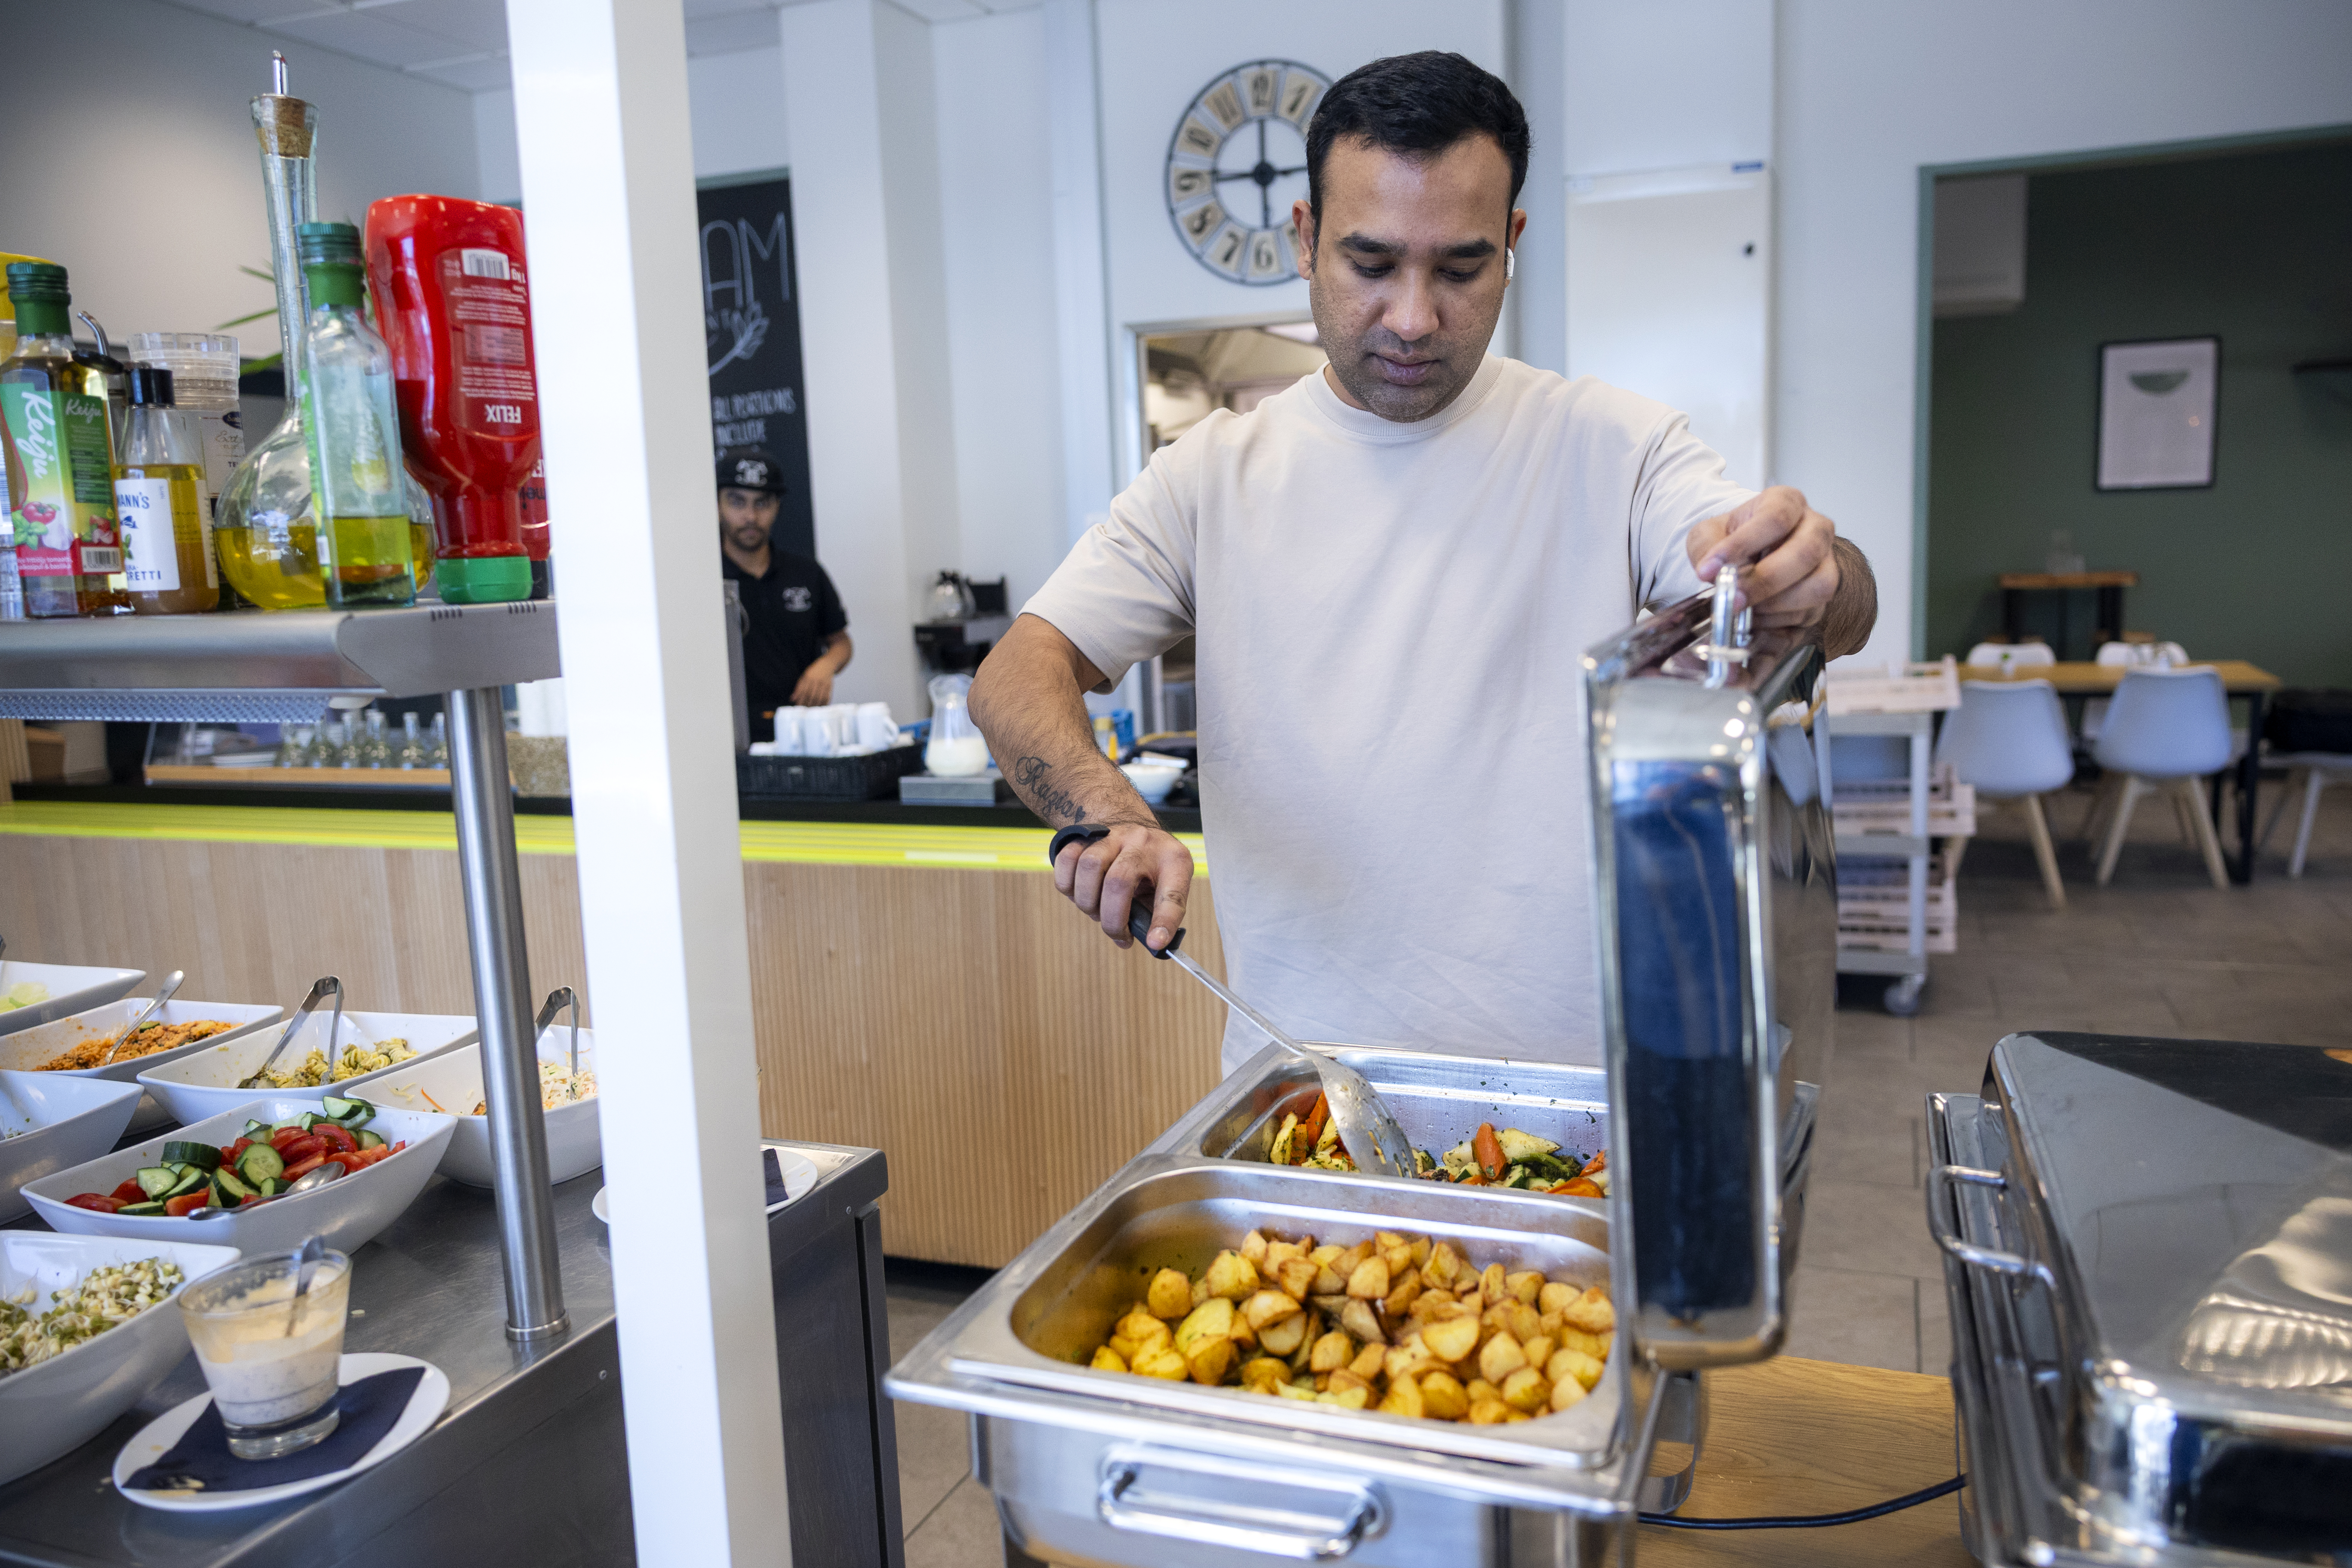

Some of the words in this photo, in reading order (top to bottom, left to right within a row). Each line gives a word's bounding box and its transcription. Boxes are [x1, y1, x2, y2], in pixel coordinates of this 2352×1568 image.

[1222, 230, 1240, 263] 7
[1253, 238, 1273, 270] 6
[65, 398, 102, 424] Keiju
[484, 404, 522, 424] FELIX
[16, 391, 55, 479] Keiju
